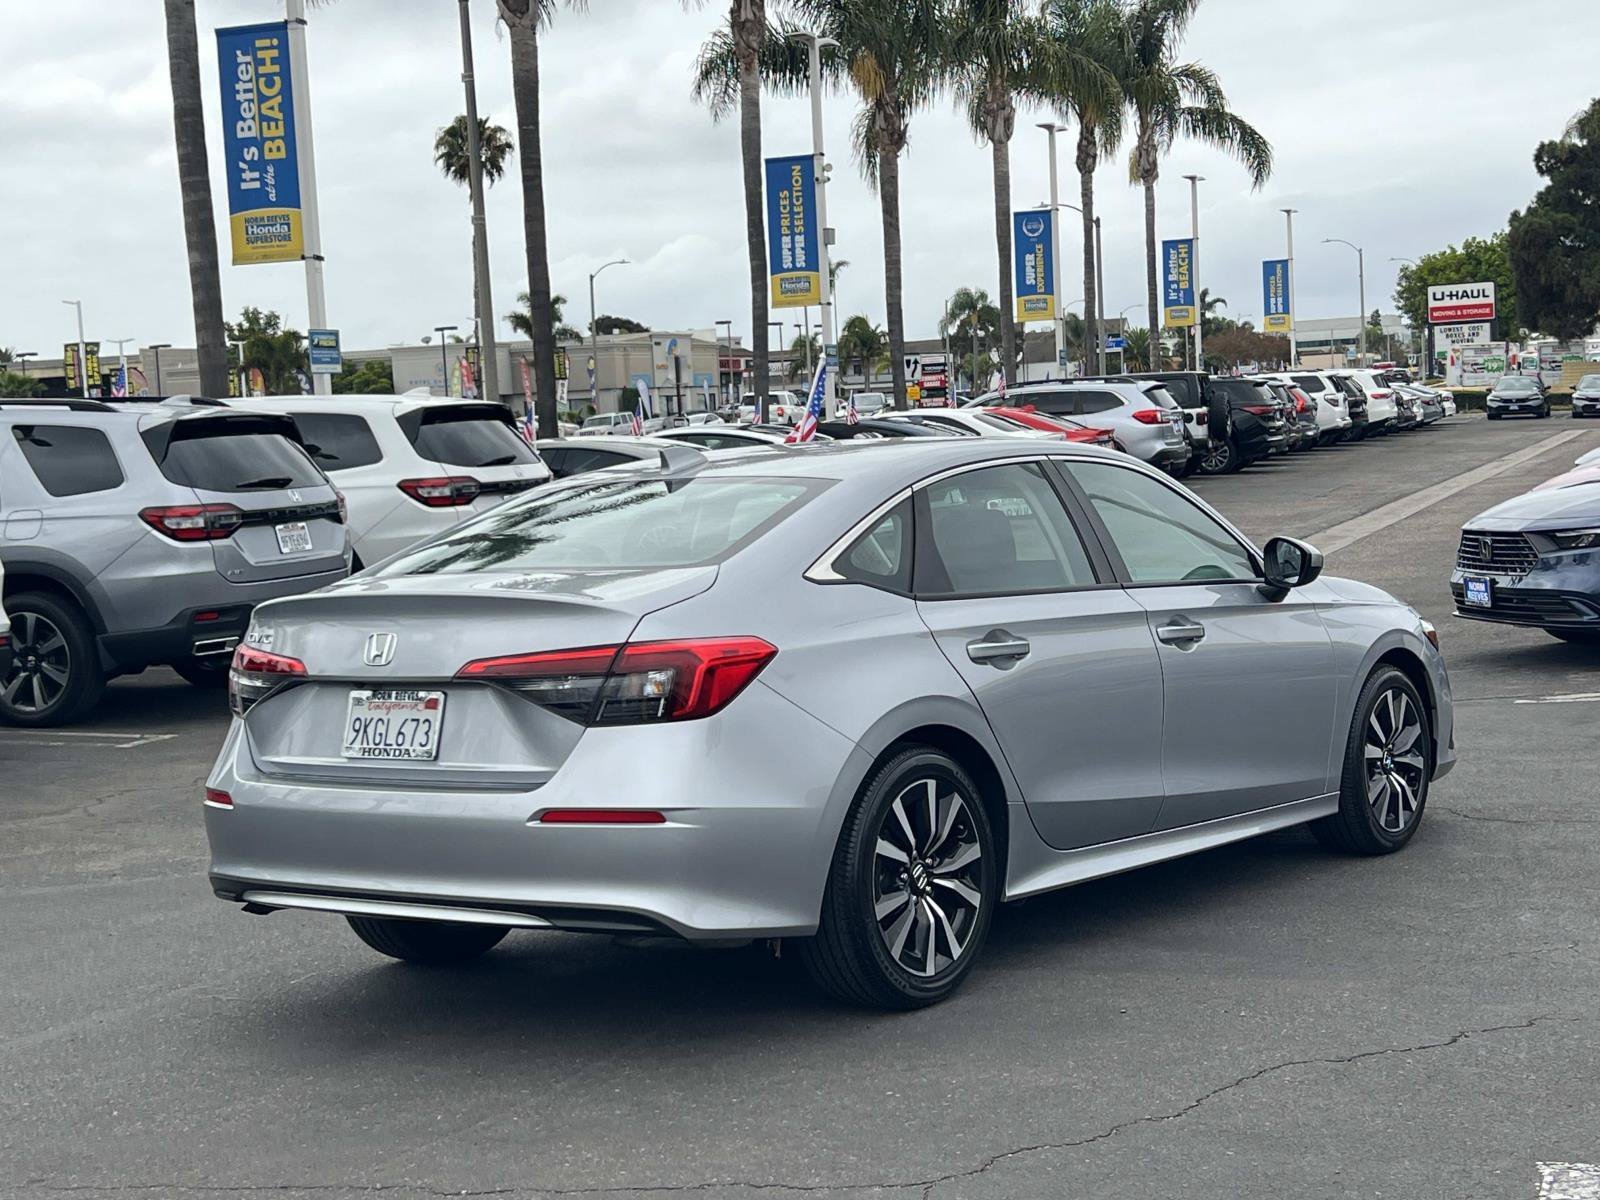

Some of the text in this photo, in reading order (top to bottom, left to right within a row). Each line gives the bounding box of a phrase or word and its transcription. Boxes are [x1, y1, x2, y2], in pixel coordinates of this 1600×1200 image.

[255, 37, 288, 161] BEACH!
[236, 49, 260, 192] It's Better
[263, 163, 275, 186] the
[792, 165, 806, 268] SUPER SELECTION
[247, 223, 289, 235] Honda
[780, 190, 792, 269] SUPER PRICES
[1025, 253, 1036, 285] SUPER
[1168, 248, 1178, 300] It's Better
[1178, 244, 1189, 289] BEACH!
[1432, 288, 1490, 301] U-HAUL
[1463, 307, 1491, 315] STORAGE
[1467, 591, 1488, 601] REEVES
[1468, 581, 1485, 592] NORM
[395, 690, 419, 701] REEVES
[368, 702, 425, 715] California
[349, 717, 432, 748] 9KGL673
[361, 747, 412, 758] HONDA
